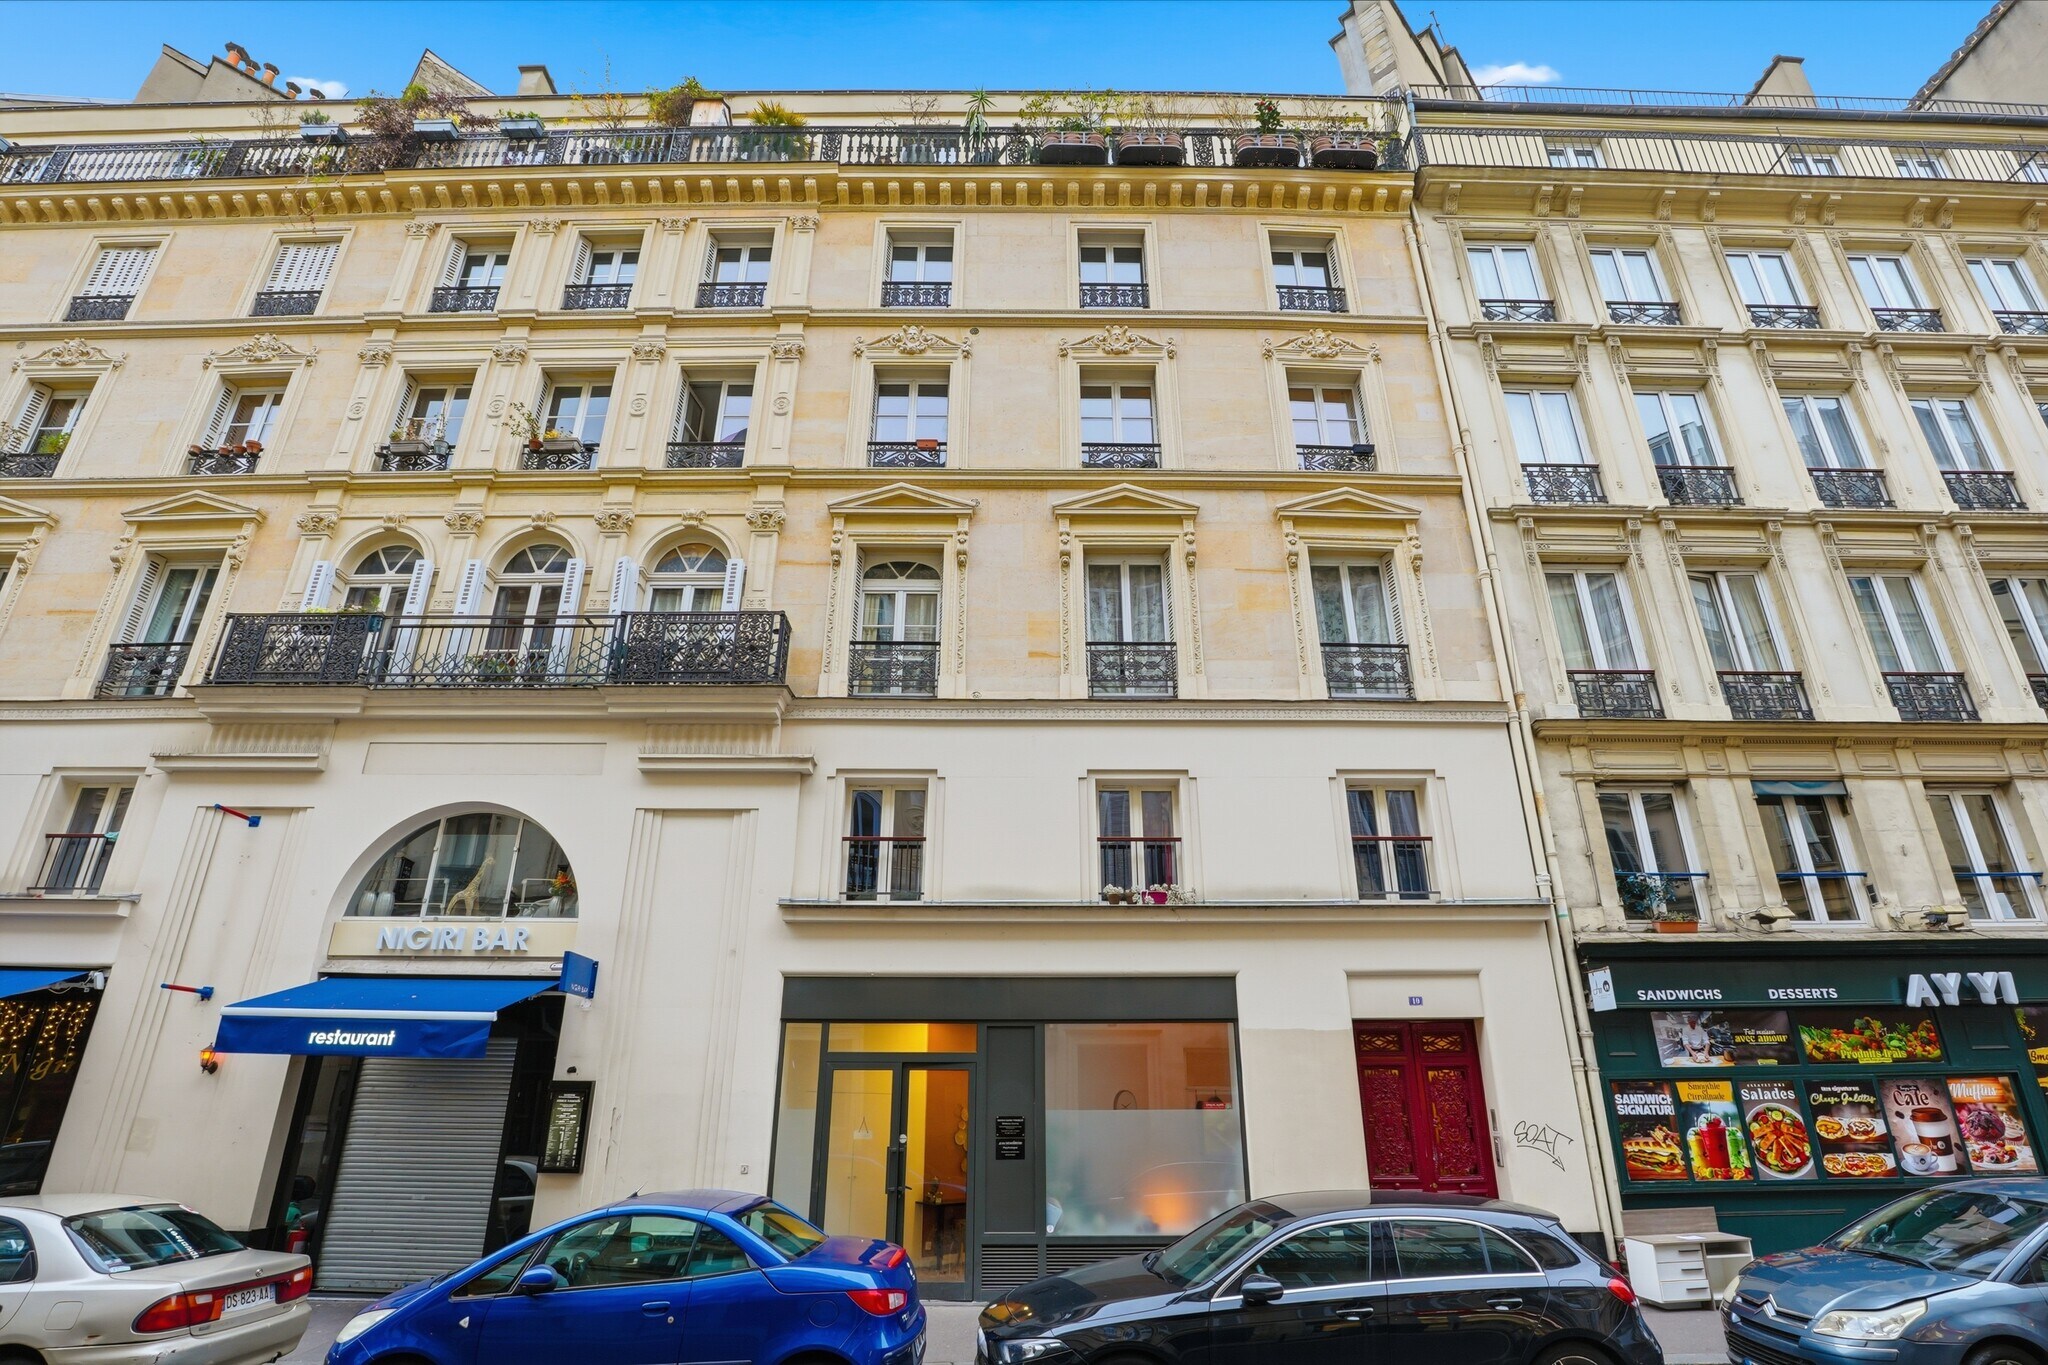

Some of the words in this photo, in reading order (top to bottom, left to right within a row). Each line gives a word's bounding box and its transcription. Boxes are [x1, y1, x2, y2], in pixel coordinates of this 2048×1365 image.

[376, 926, 467, 951] NIGIRI
[471, 927, 530, 951] BAR
[1637, 988, 1723, 1000] SANDWICHS
[1768, 987, 1838, 999] DESSERTS
[308, 1029, 396, 1046] restaurant
[1734, 1035, 1756, 1043] avec
[1741, 1088, 1796, 1100] Salades
[1948, 1083, 1997, 1101] Muffins
